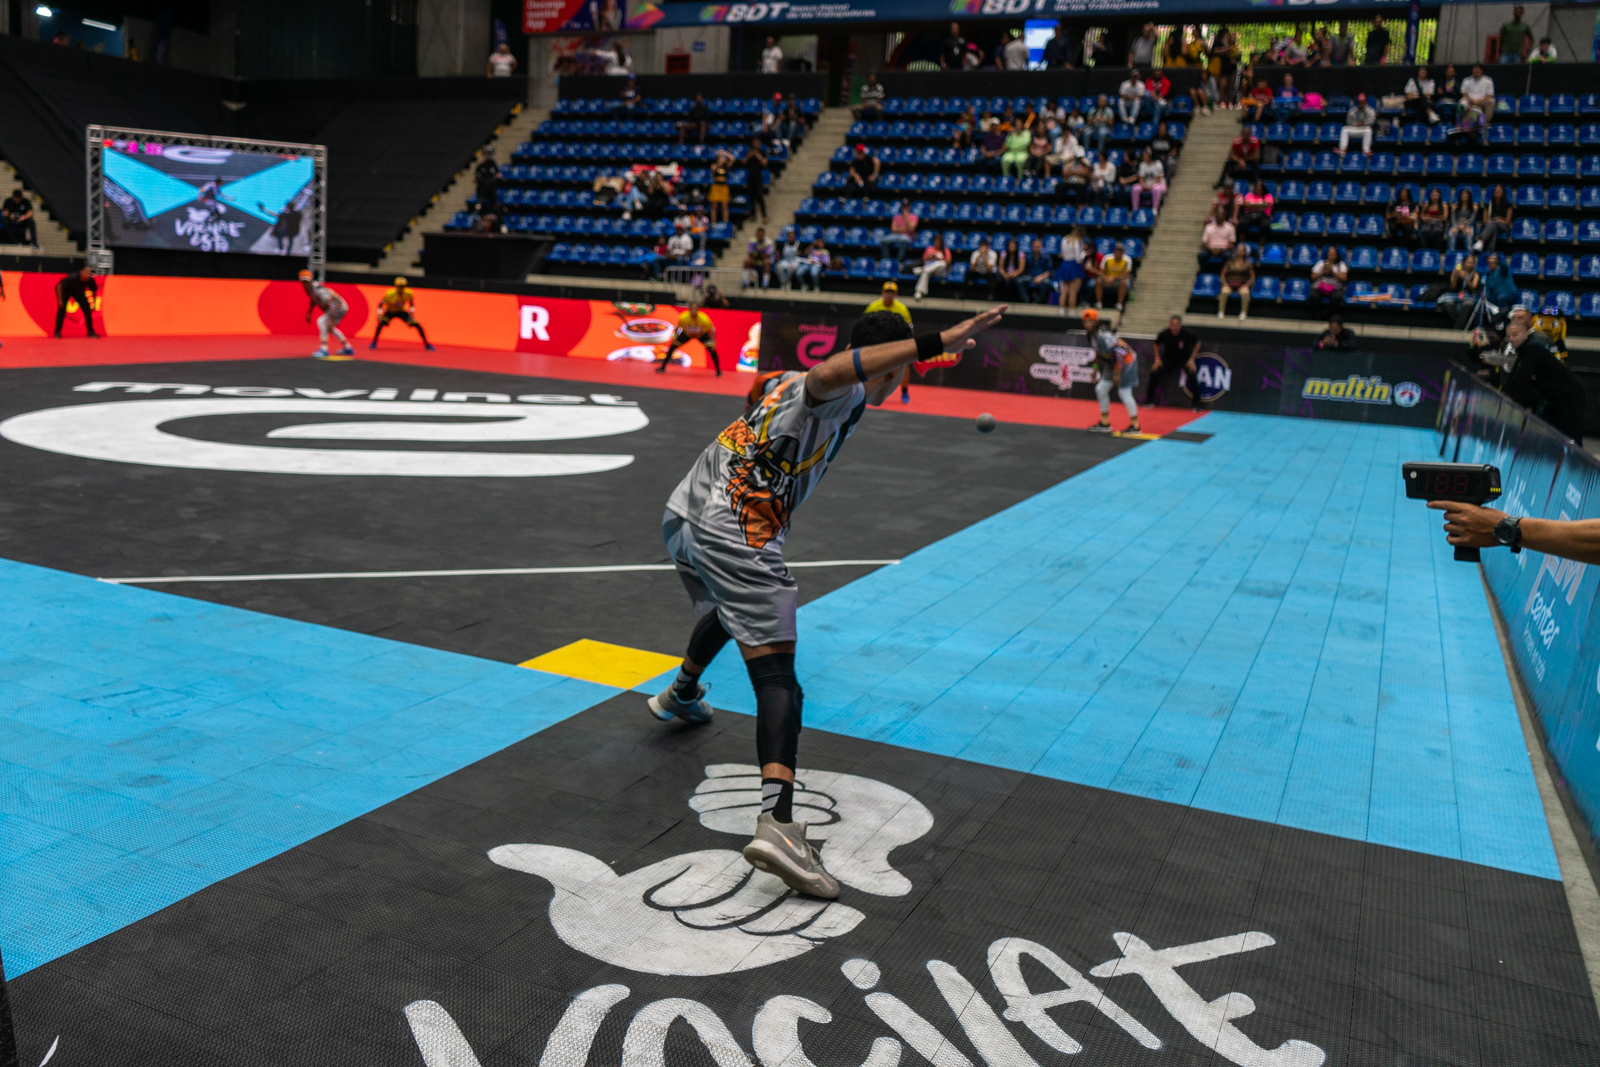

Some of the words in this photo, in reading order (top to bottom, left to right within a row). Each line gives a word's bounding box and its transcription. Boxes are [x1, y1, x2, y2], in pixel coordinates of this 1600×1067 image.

[725, 2, 790, 22] BDT
[520, 304, 550, 341] R
[72, 380, 641, 407] movilnet
[1530, 591, 1560, 651] center
